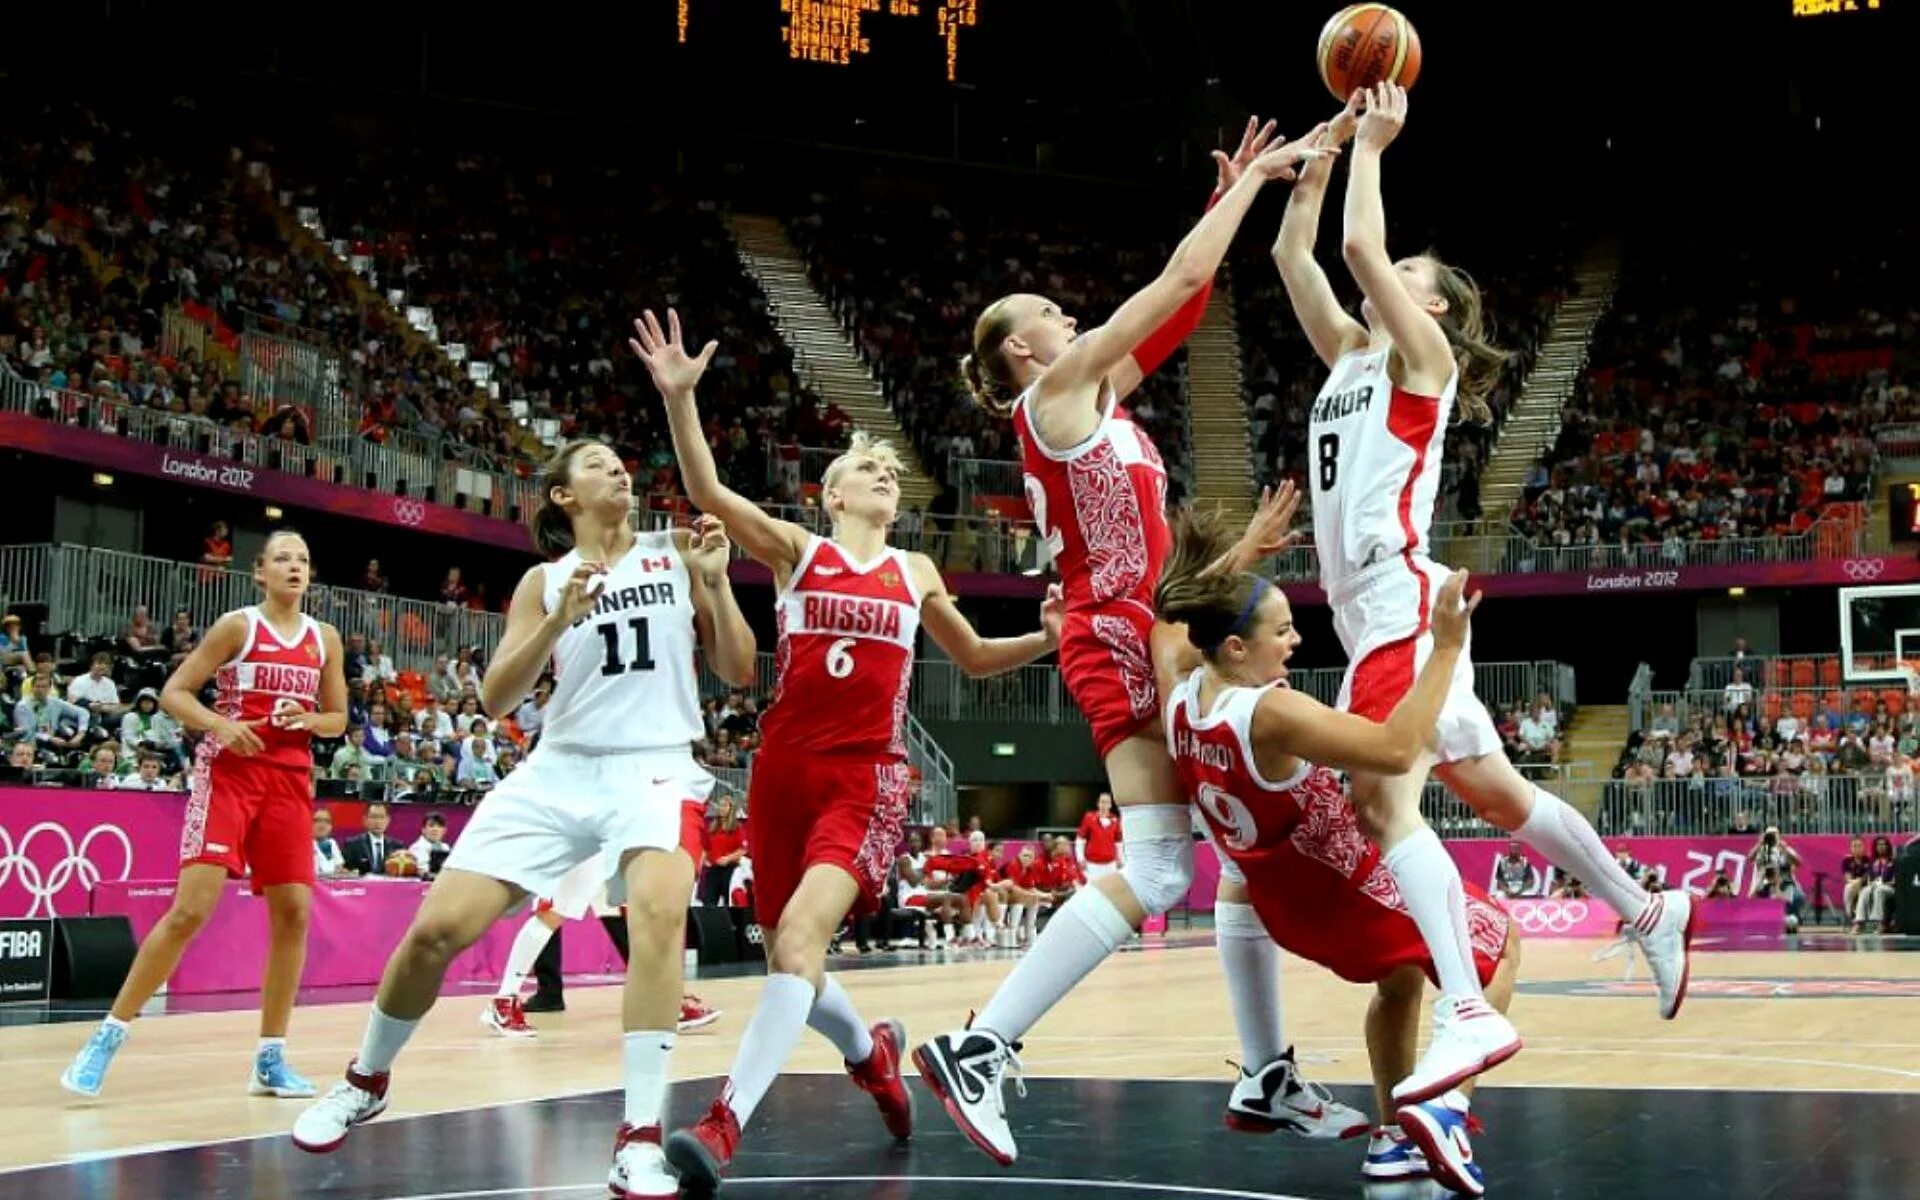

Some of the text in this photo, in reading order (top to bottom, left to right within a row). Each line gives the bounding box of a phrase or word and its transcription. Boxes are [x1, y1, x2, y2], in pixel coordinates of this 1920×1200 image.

[790, 43, 849, 65] STEALS
[161, 453, 255, 490] London 2012
[1318, 432, 1340, 492] 8
[1586, 571, 1680, 590] London 2012
[804, 594, 901, 640] RUSSIA
[597, 616, 656, 677] 11
[825, 637, 857, 679] 6
[1198, 781, 1259, 851] 9
[0, 930, 42, 959] FIBA
